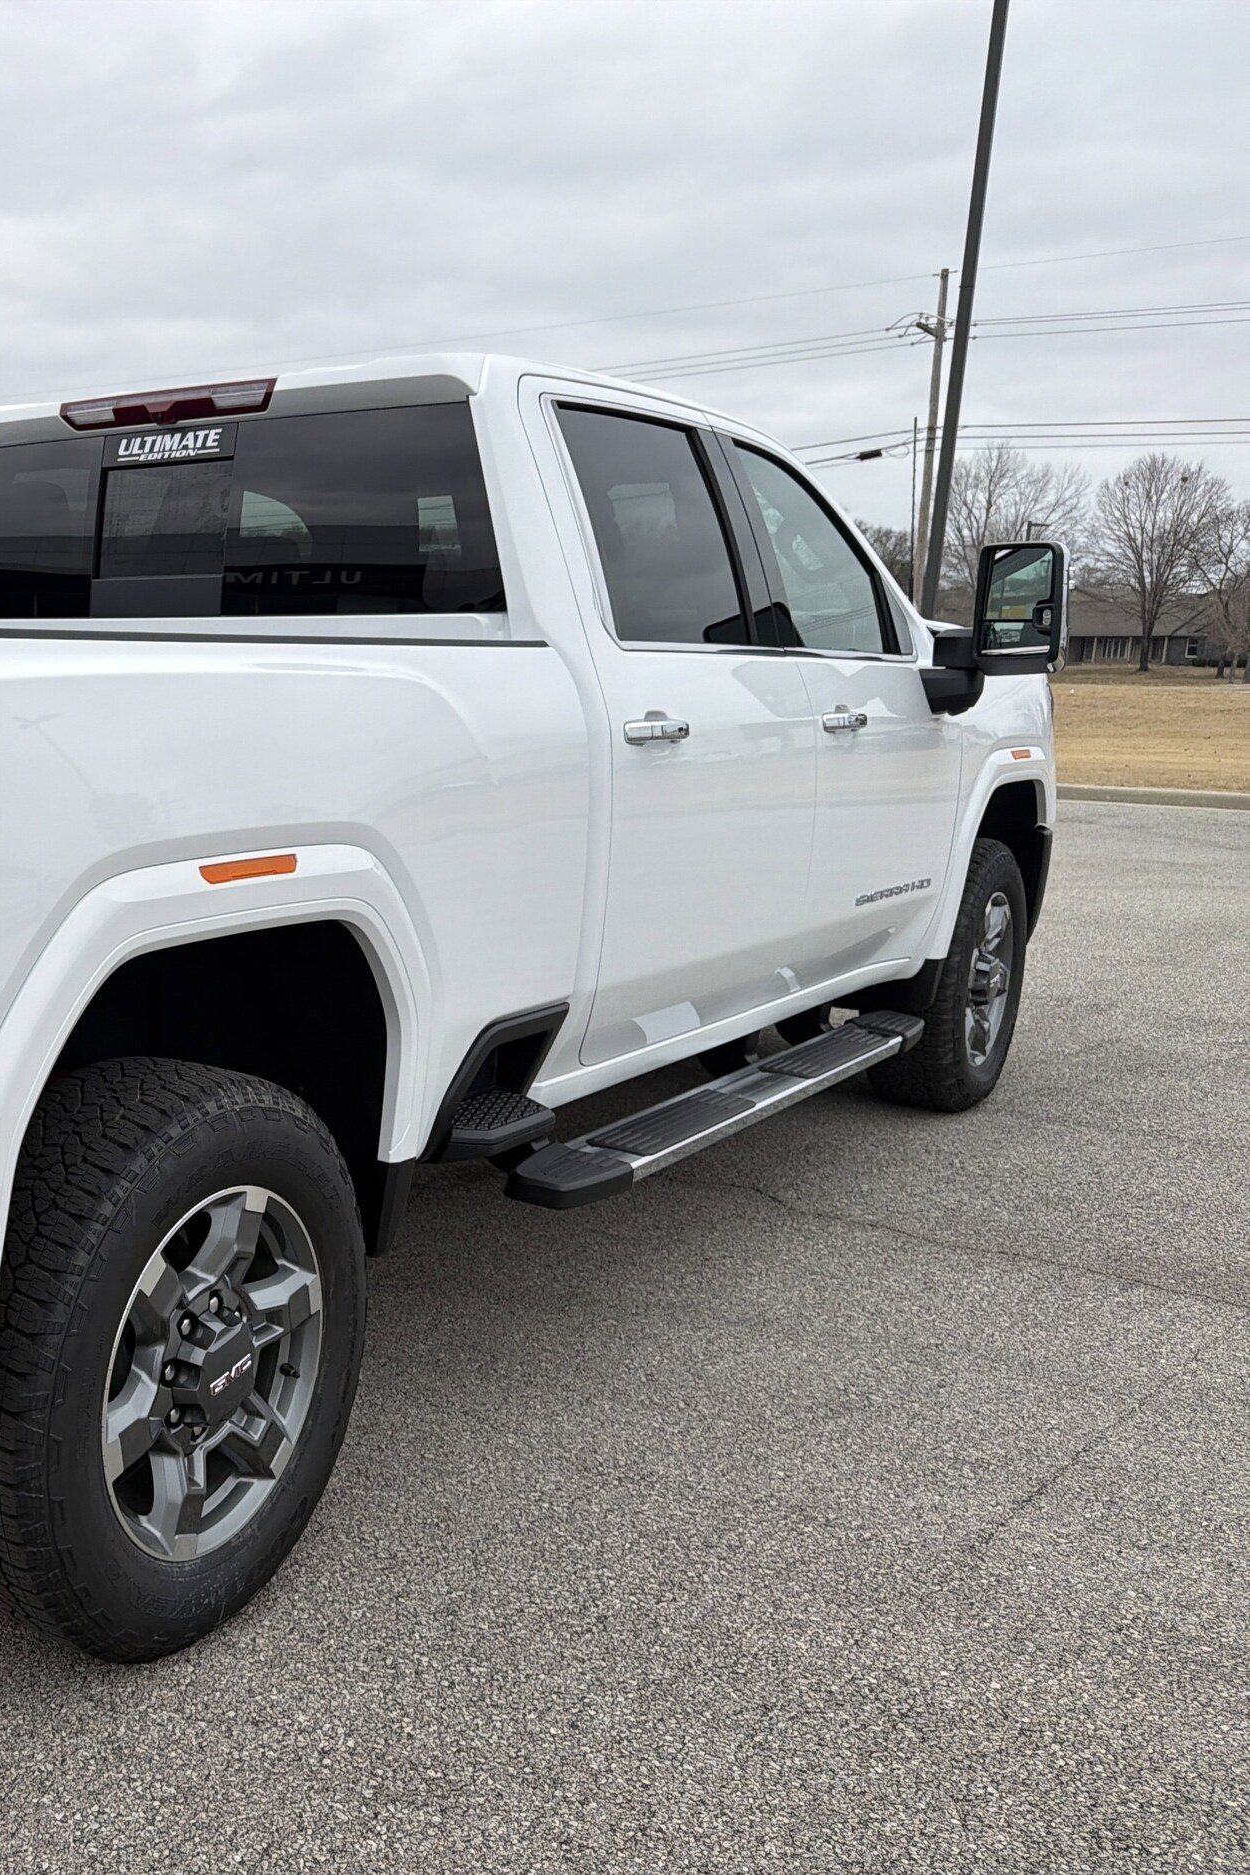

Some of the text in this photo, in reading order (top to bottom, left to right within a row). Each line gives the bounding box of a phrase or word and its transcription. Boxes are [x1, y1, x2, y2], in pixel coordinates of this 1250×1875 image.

[118, 428, 223, 456] ULTIMATE
[139, 449, 198, 461] EDITION
[855, 878, 932, 906] SIERRA HD
[210, 1353, 253, 1397] GMC
